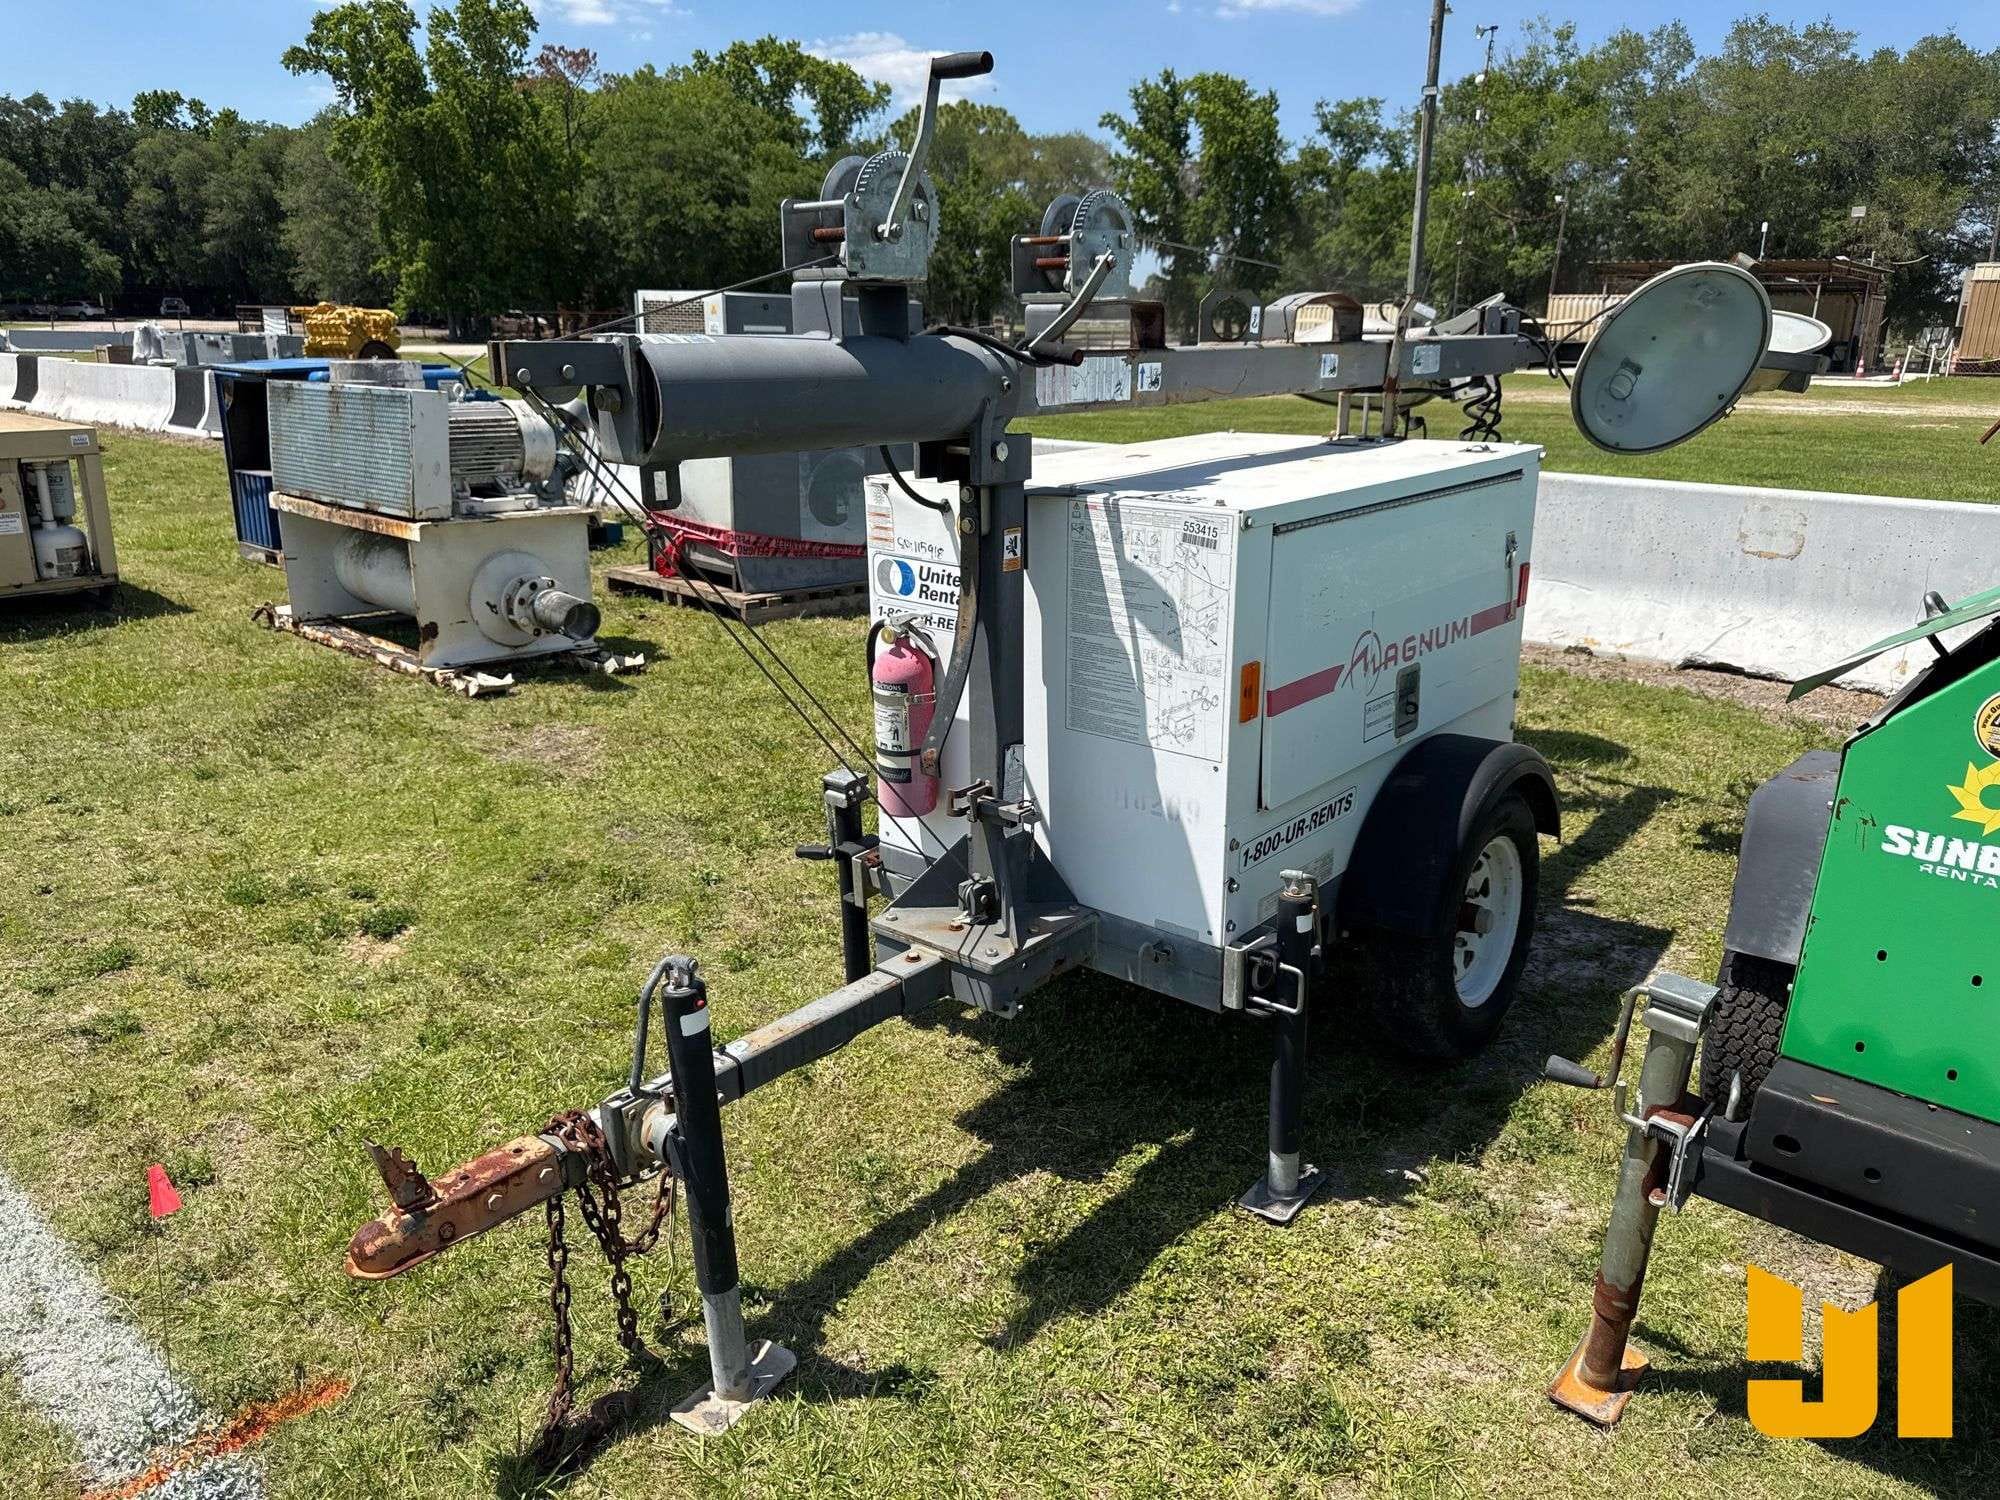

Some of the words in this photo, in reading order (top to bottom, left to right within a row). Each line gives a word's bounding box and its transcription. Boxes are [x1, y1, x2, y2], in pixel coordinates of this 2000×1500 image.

[1183, 521, 1218, 538] 553415
[919, 566, 960, 588] Unite
[1341, 616, 1468, 689] MAGNUM
[1242, 792, 1354, 867] 1-800-UR-RENTS
[1880, 824, 2000, 877] SUNB
[1919, 863, 1999, 889] RENTA
